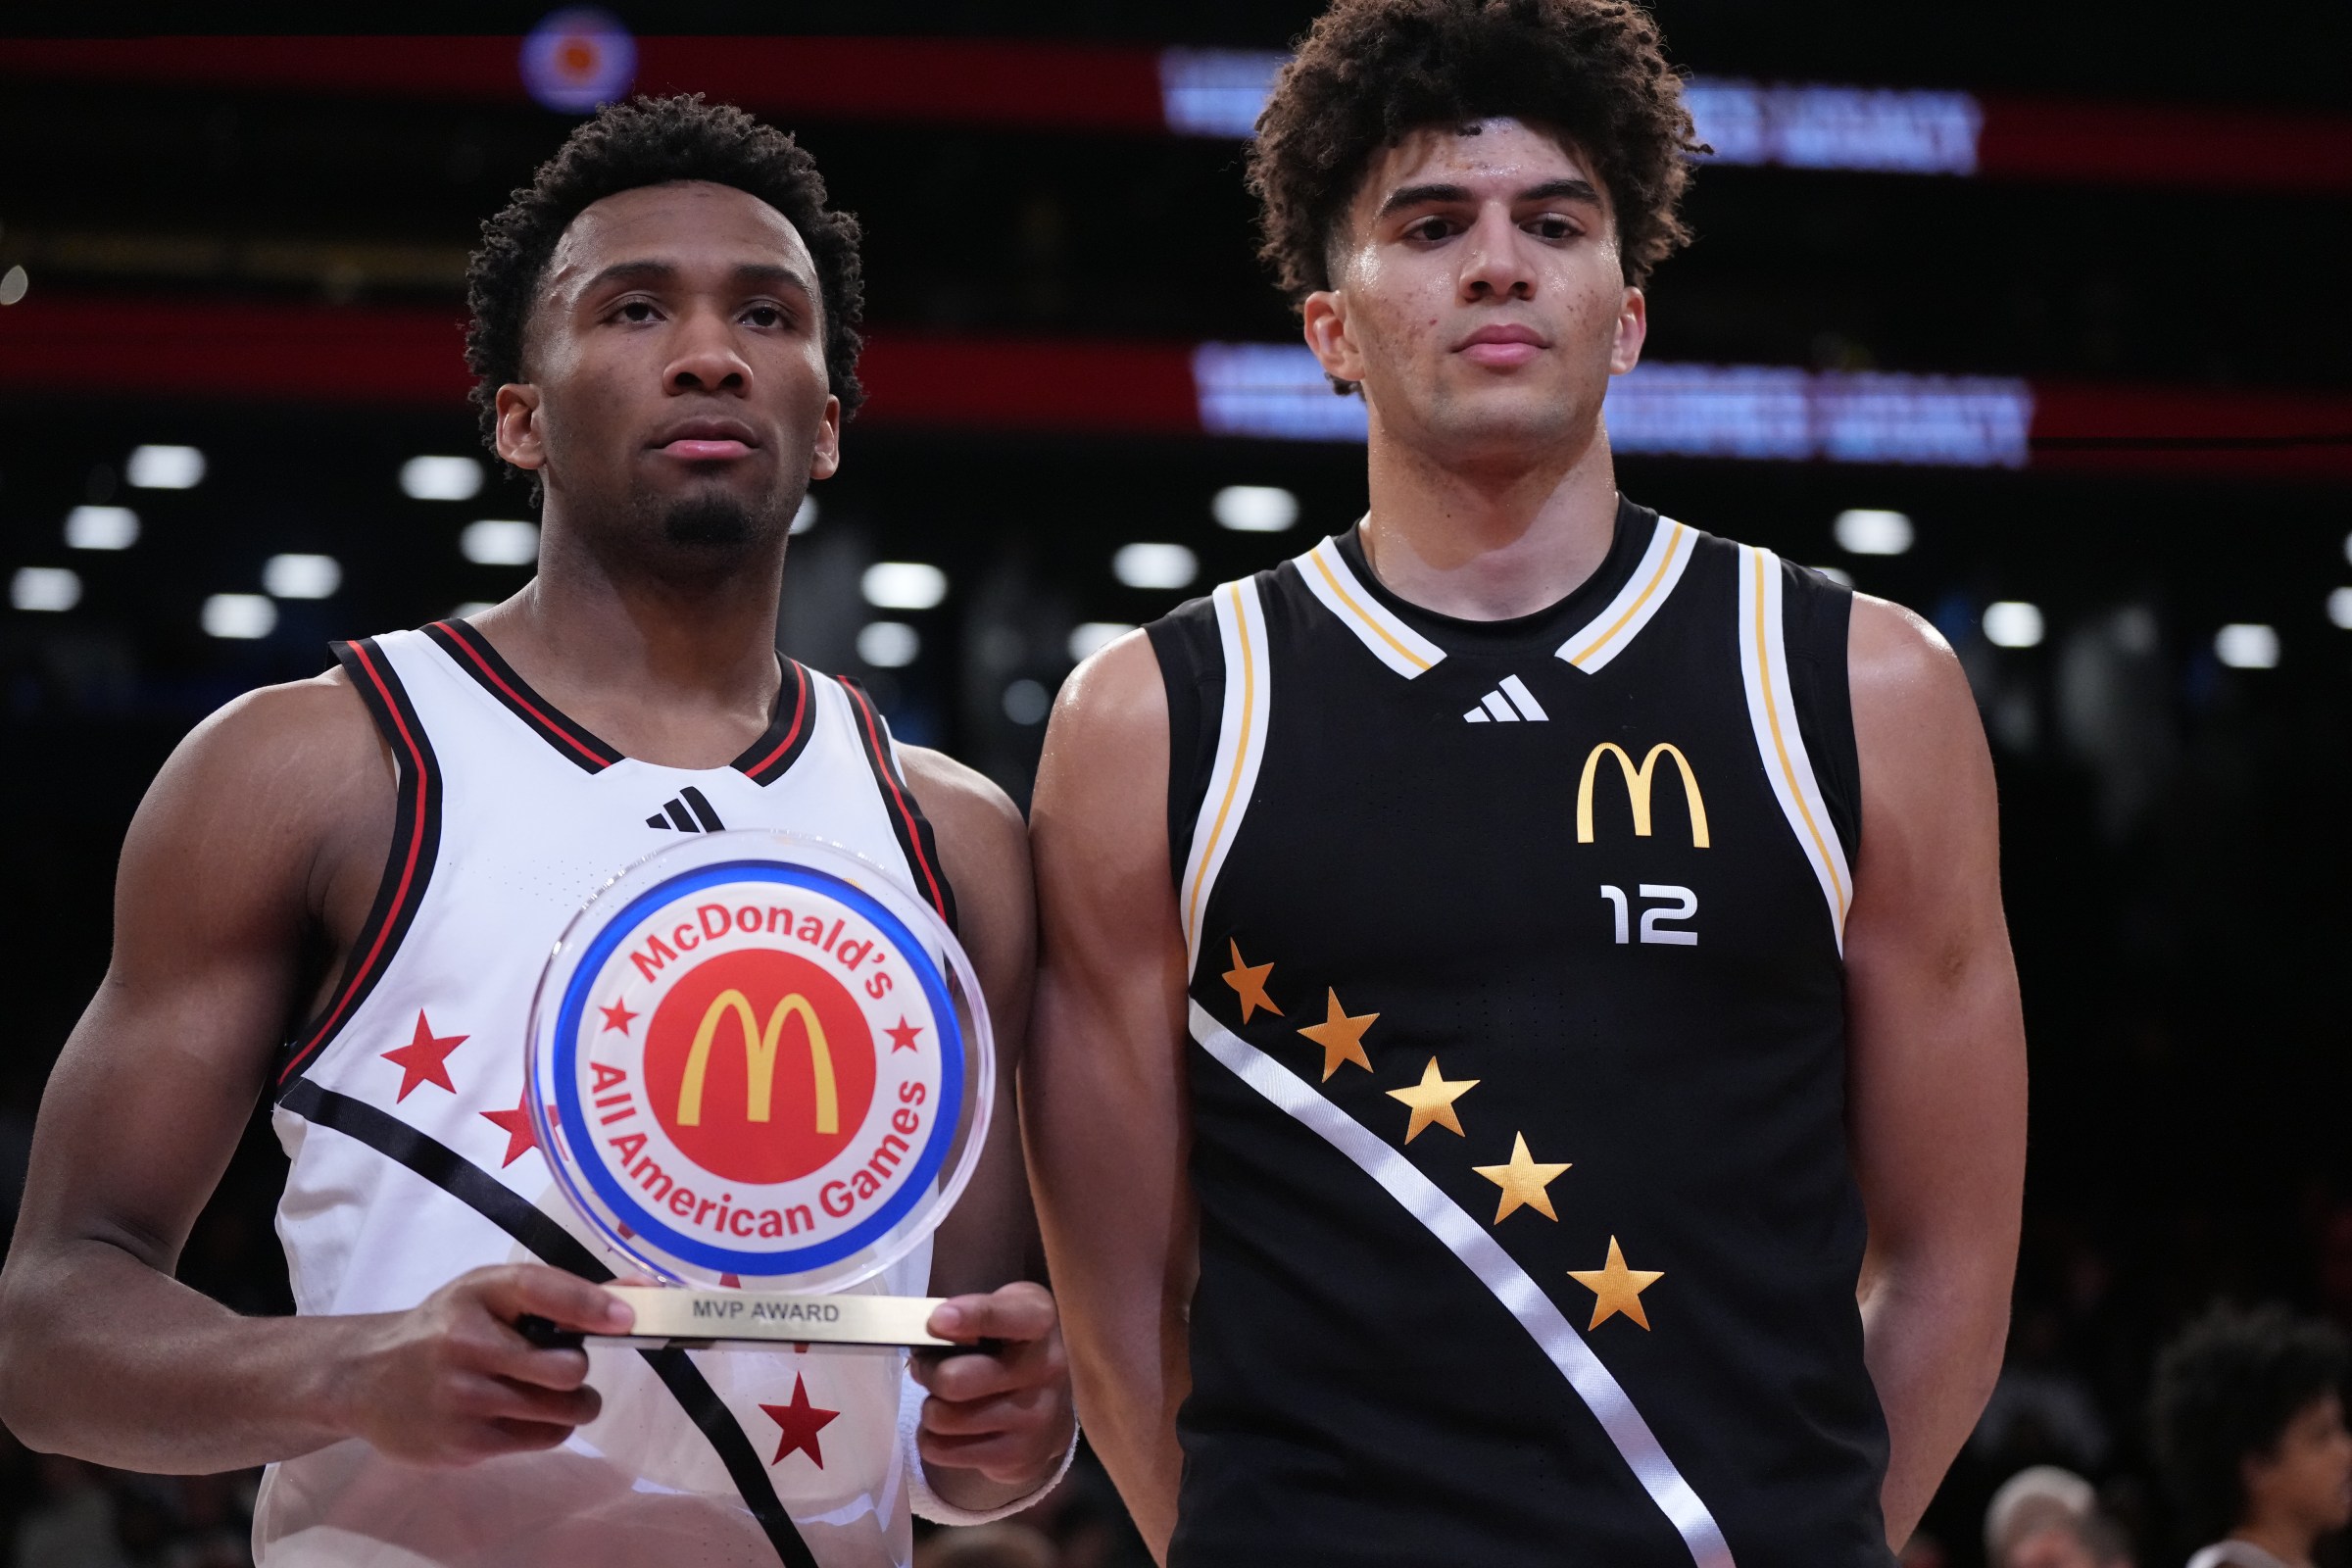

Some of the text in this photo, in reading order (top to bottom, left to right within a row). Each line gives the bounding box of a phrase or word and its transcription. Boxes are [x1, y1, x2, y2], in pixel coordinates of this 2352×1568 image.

[629, 903, 893, 1001] McDonald's
[1599, 883, 1698, 946] 12
[590, 1061, 926, 1239] All American Games
[692, 1299, 840, 1323] MVP AWARD
